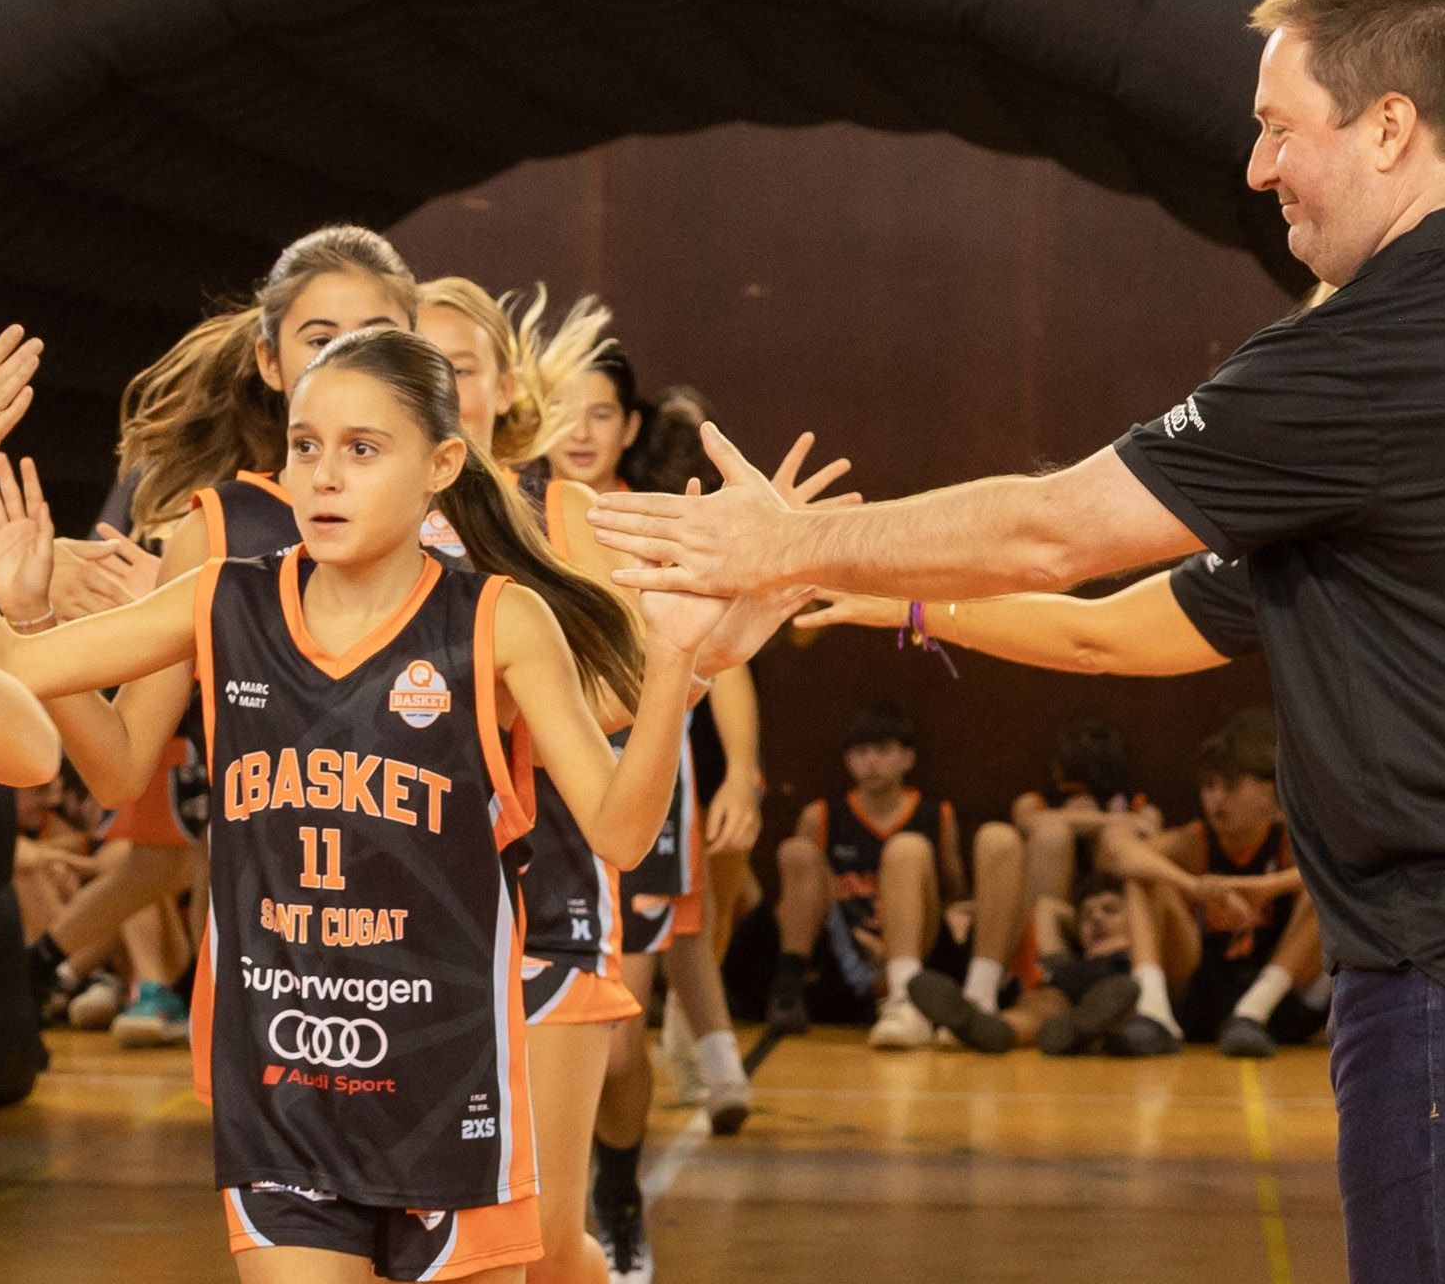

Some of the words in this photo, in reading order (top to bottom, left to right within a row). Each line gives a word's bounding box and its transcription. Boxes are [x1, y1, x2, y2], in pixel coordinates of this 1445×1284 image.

[240, 680, 270, 696] MARC
[238, 695, 267, 710] MART
[394, 694, 448, 708] BASKET
[299, 826, 346, 891] 11
[321, 907, 408, 947] CUGAT
[334, 1075, 397, 1095] Sport
[461, 1117, 496, 1140] 2XS
